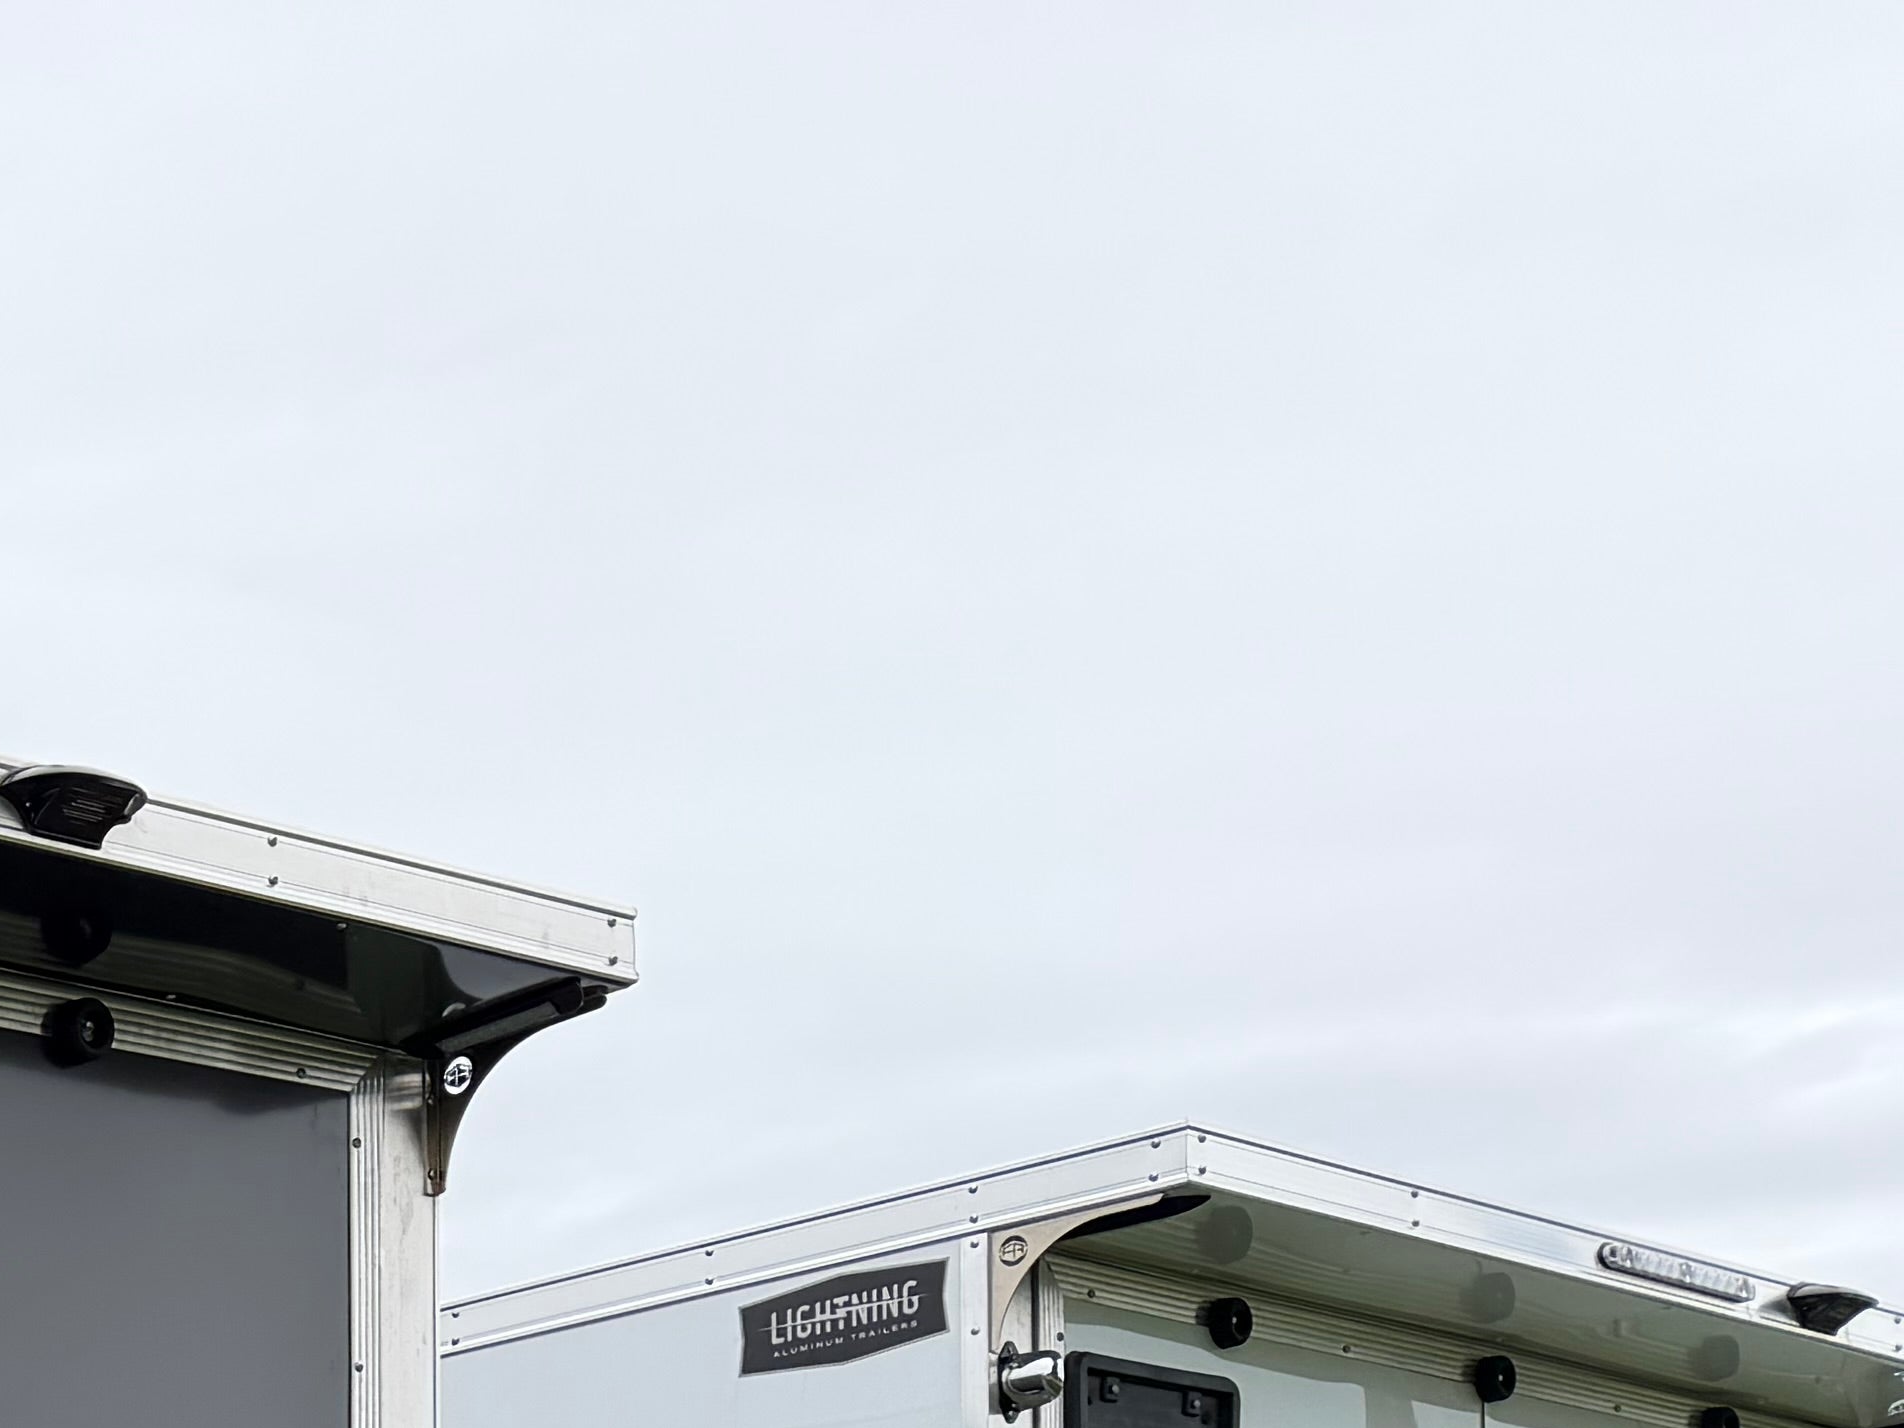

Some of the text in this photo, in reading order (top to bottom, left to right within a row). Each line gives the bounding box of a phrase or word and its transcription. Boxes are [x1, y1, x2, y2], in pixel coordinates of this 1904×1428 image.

[770, 1280, 921, 1345] LIGHTNING
[774, 1320, 918, 1357] ALUMINUM TRAILERS
